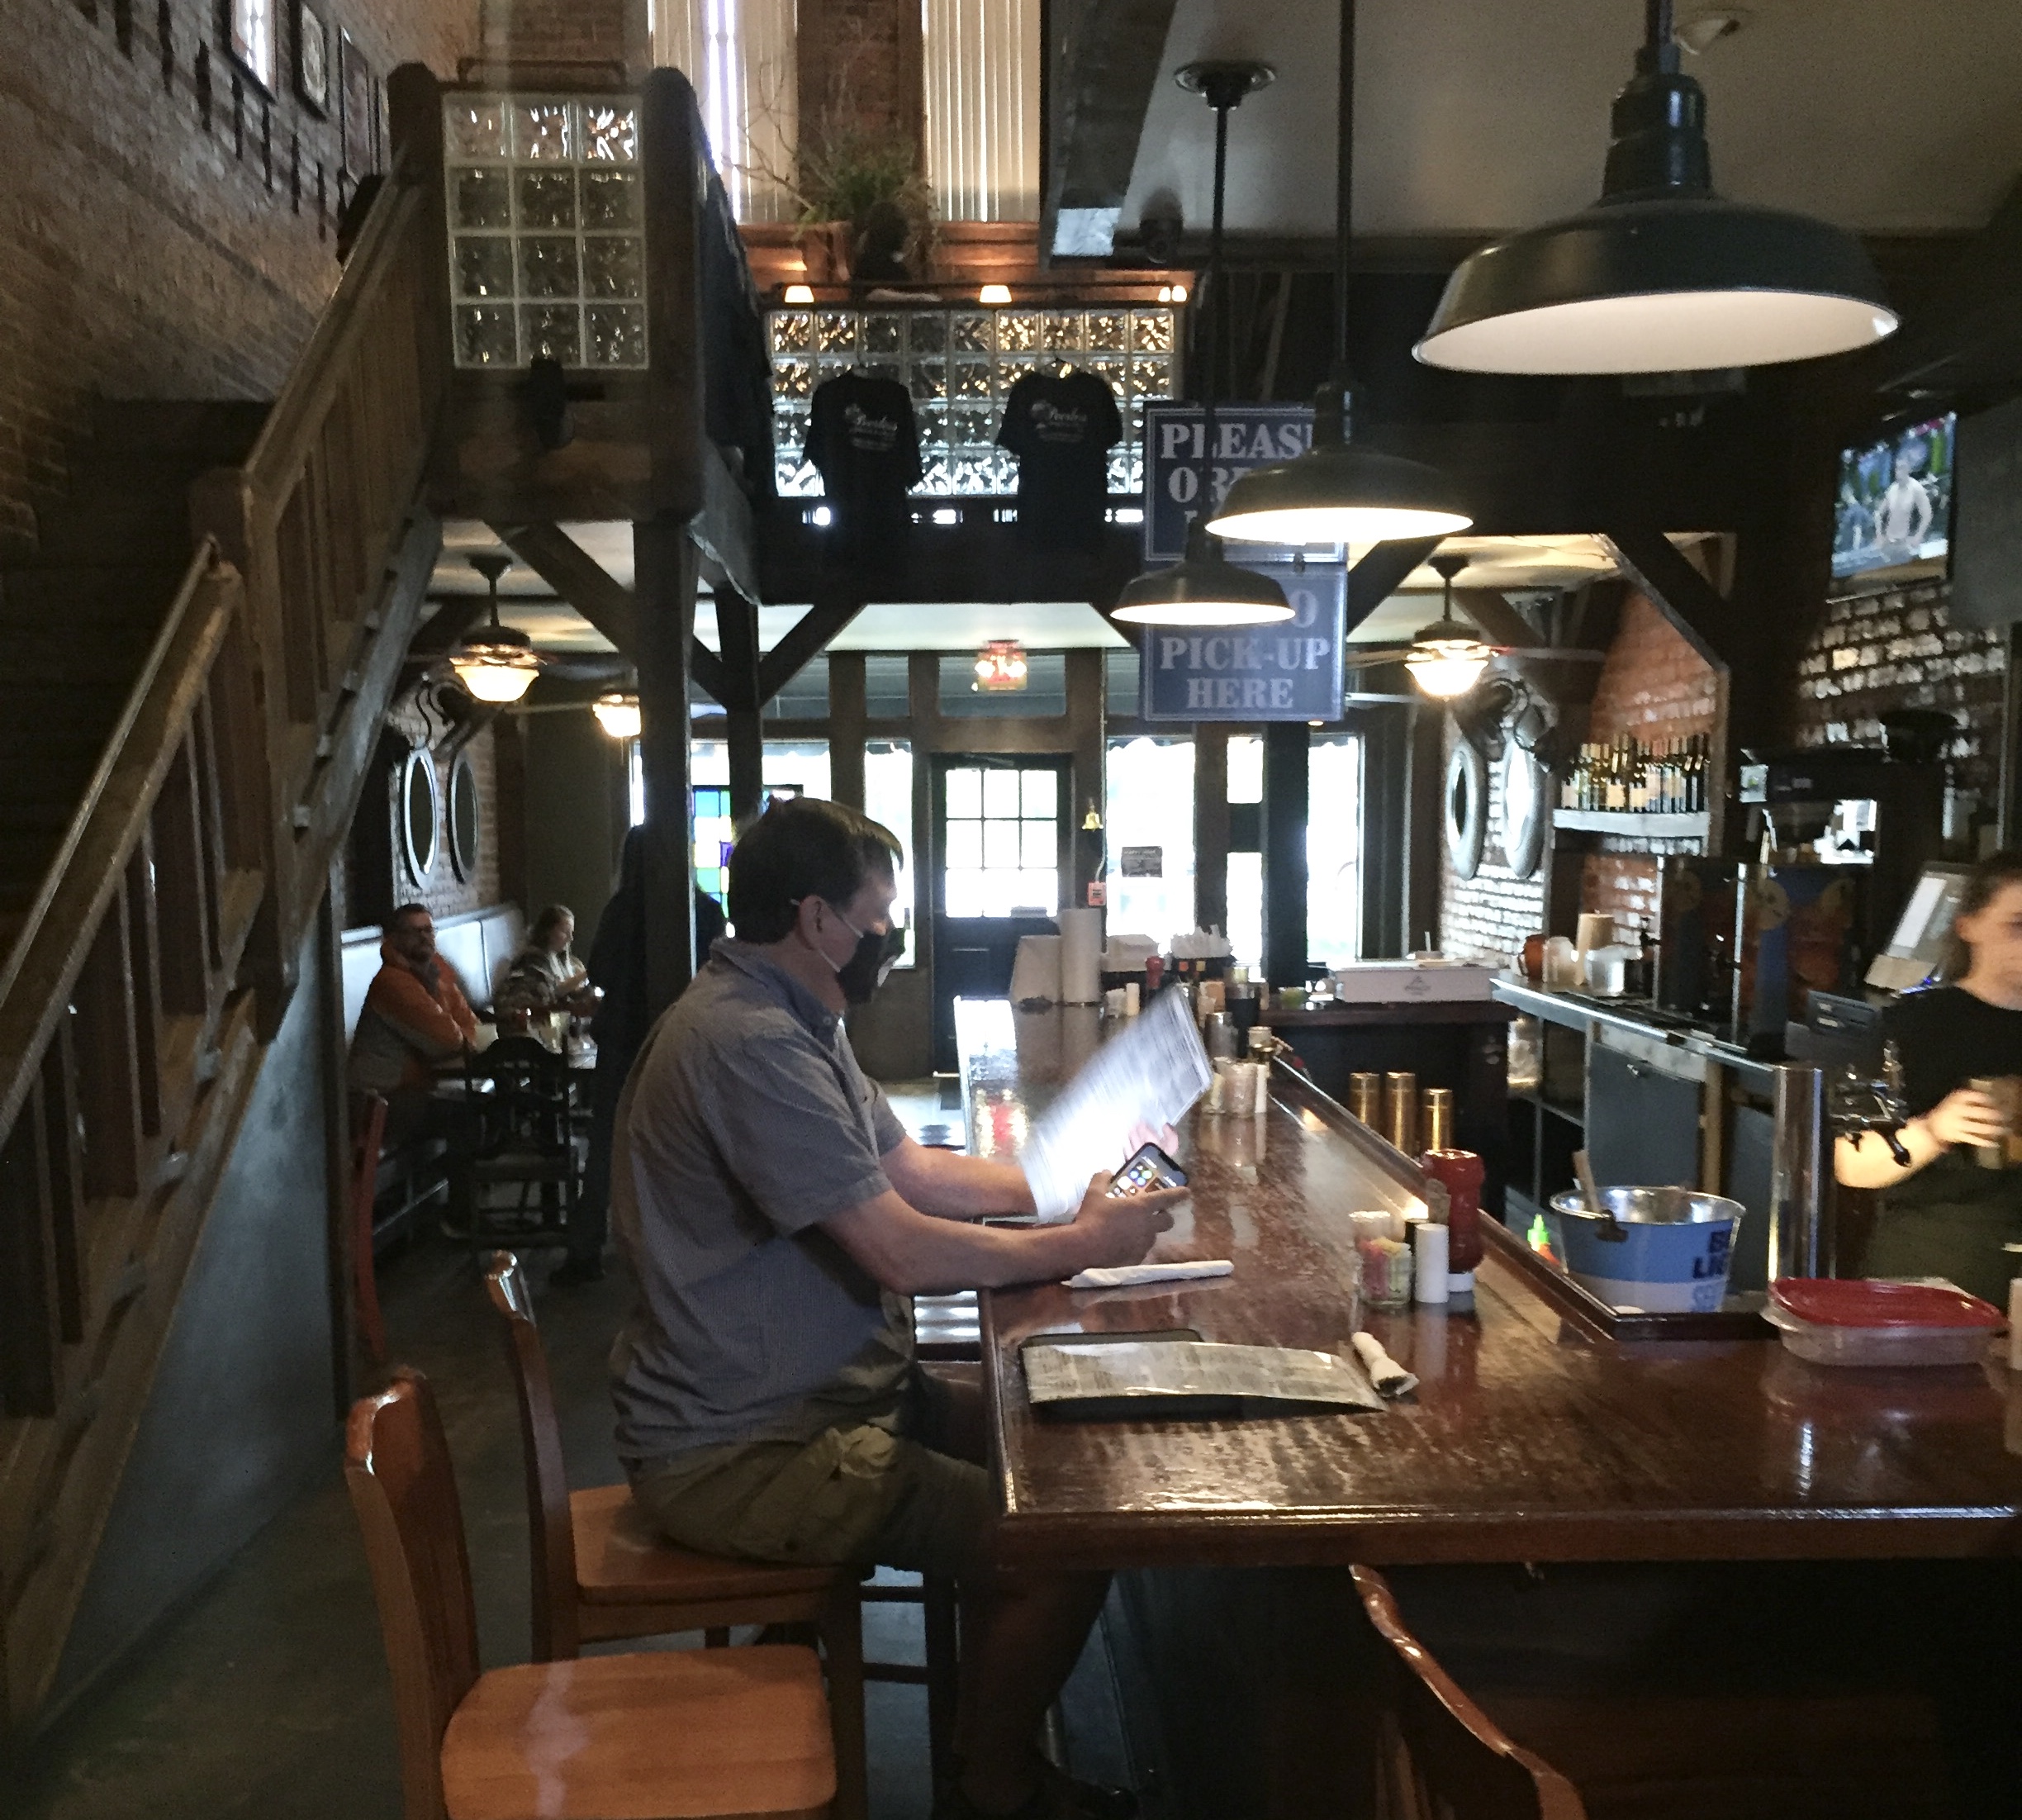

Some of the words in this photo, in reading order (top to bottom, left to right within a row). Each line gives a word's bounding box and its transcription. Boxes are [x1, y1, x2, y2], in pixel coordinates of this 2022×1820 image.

[1161, 423, 1313, 459] PLEAS
[1160, 637, 1331, 671] PICK-UP
[1187, 677, 1294, 709] HERE
